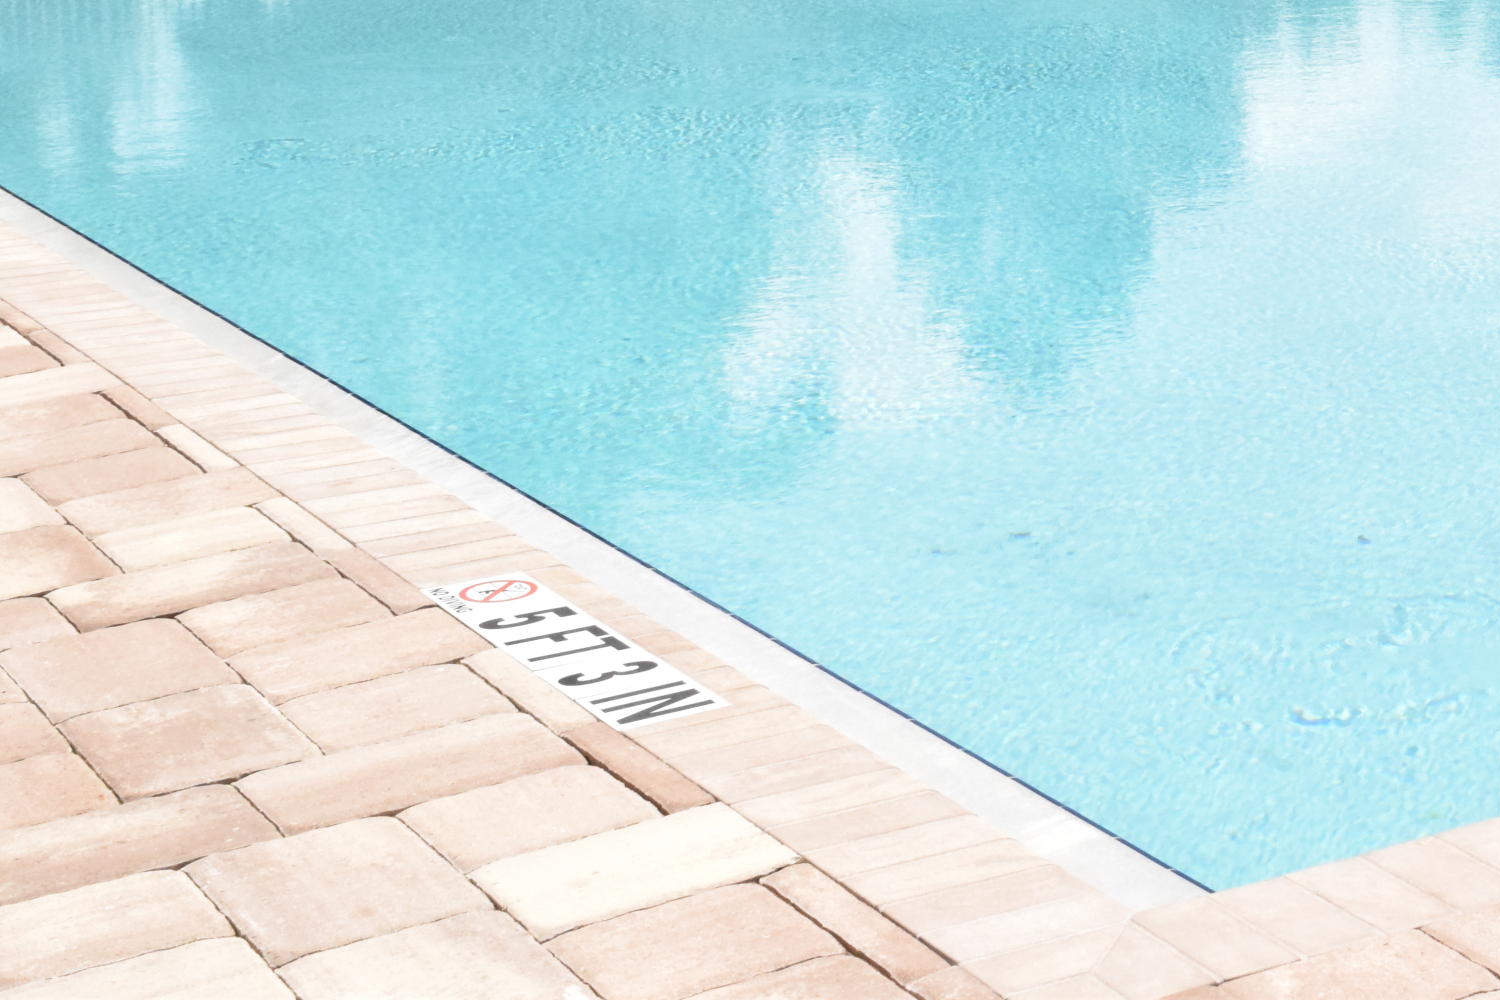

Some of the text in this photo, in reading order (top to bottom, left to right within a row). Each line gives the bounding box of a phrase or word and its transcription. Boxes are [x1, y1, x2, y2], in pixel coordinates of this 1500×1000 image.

[478, 606, 715, 725] 5 FT 3 IN
